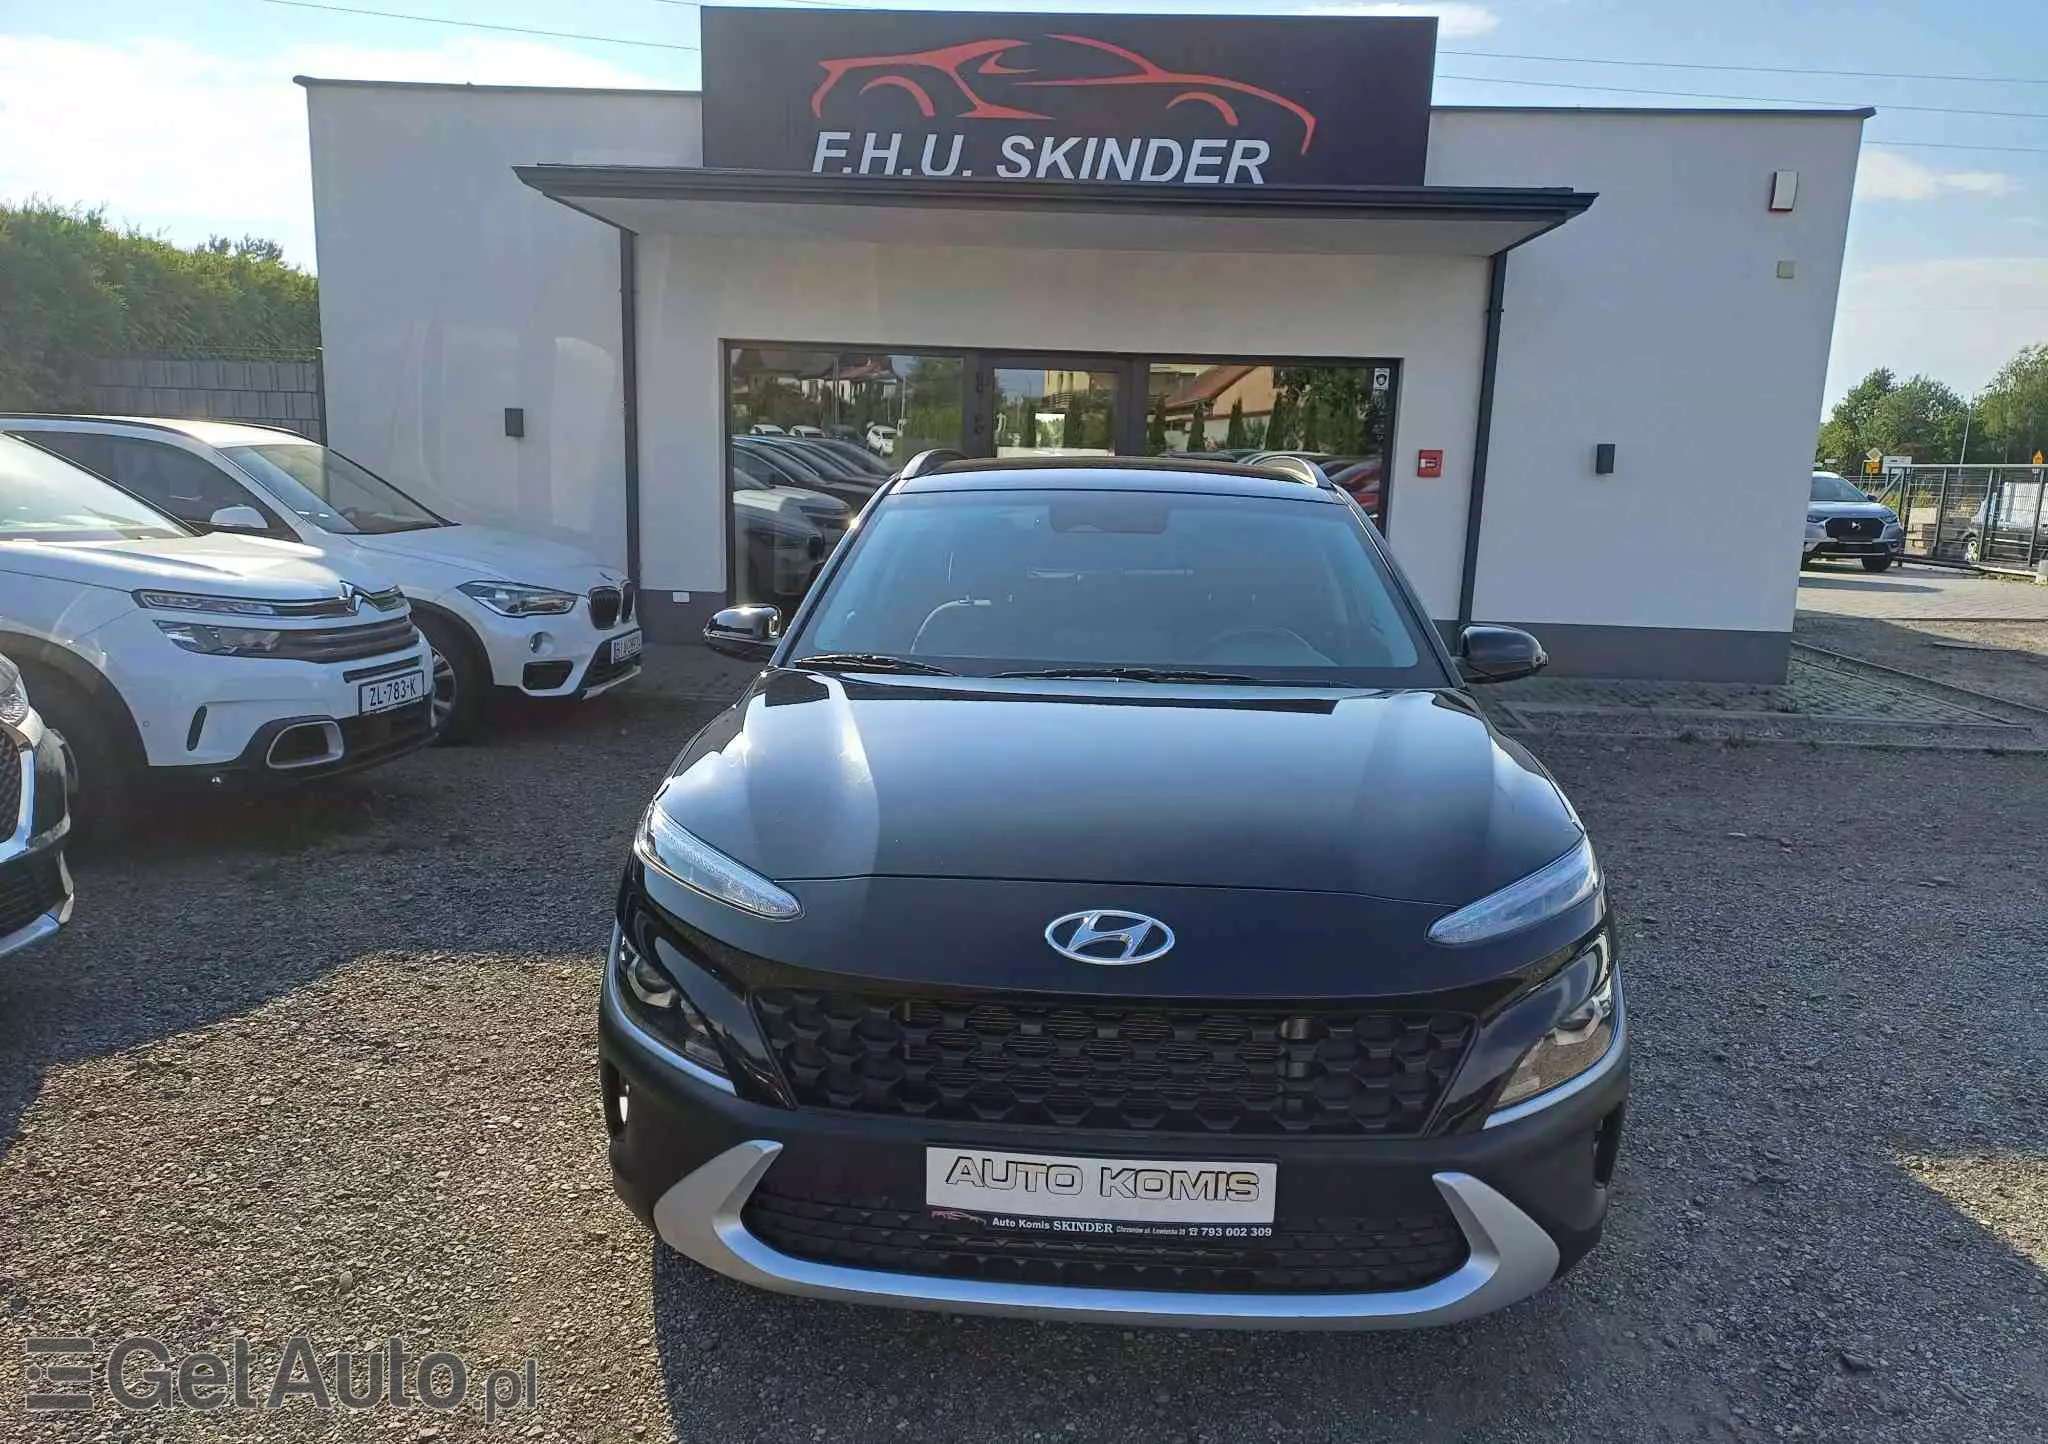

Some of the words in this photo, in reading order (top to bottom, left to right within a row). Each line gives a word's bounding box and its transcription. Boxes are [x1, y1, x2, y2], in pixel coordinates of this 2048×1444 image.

[812, 130, 973, 178] F.H.U.
[996, 135, 1272, 185] SKINDER
[946, 1155, 1083, 1196] AUTO
[1100, 1166, 1260, 1202] KOMIS
[992, 1217, 1016, 1228] Auto
[1018, 1219, 1050, 1230] Komis
[1053, 1220, 1113, 1233] SKINDER
[1201, 1227, 1223, 1237] 793
[1225, 1227, 1248, 1237] 002
[1250, 1227, 1272, 1237] 309
